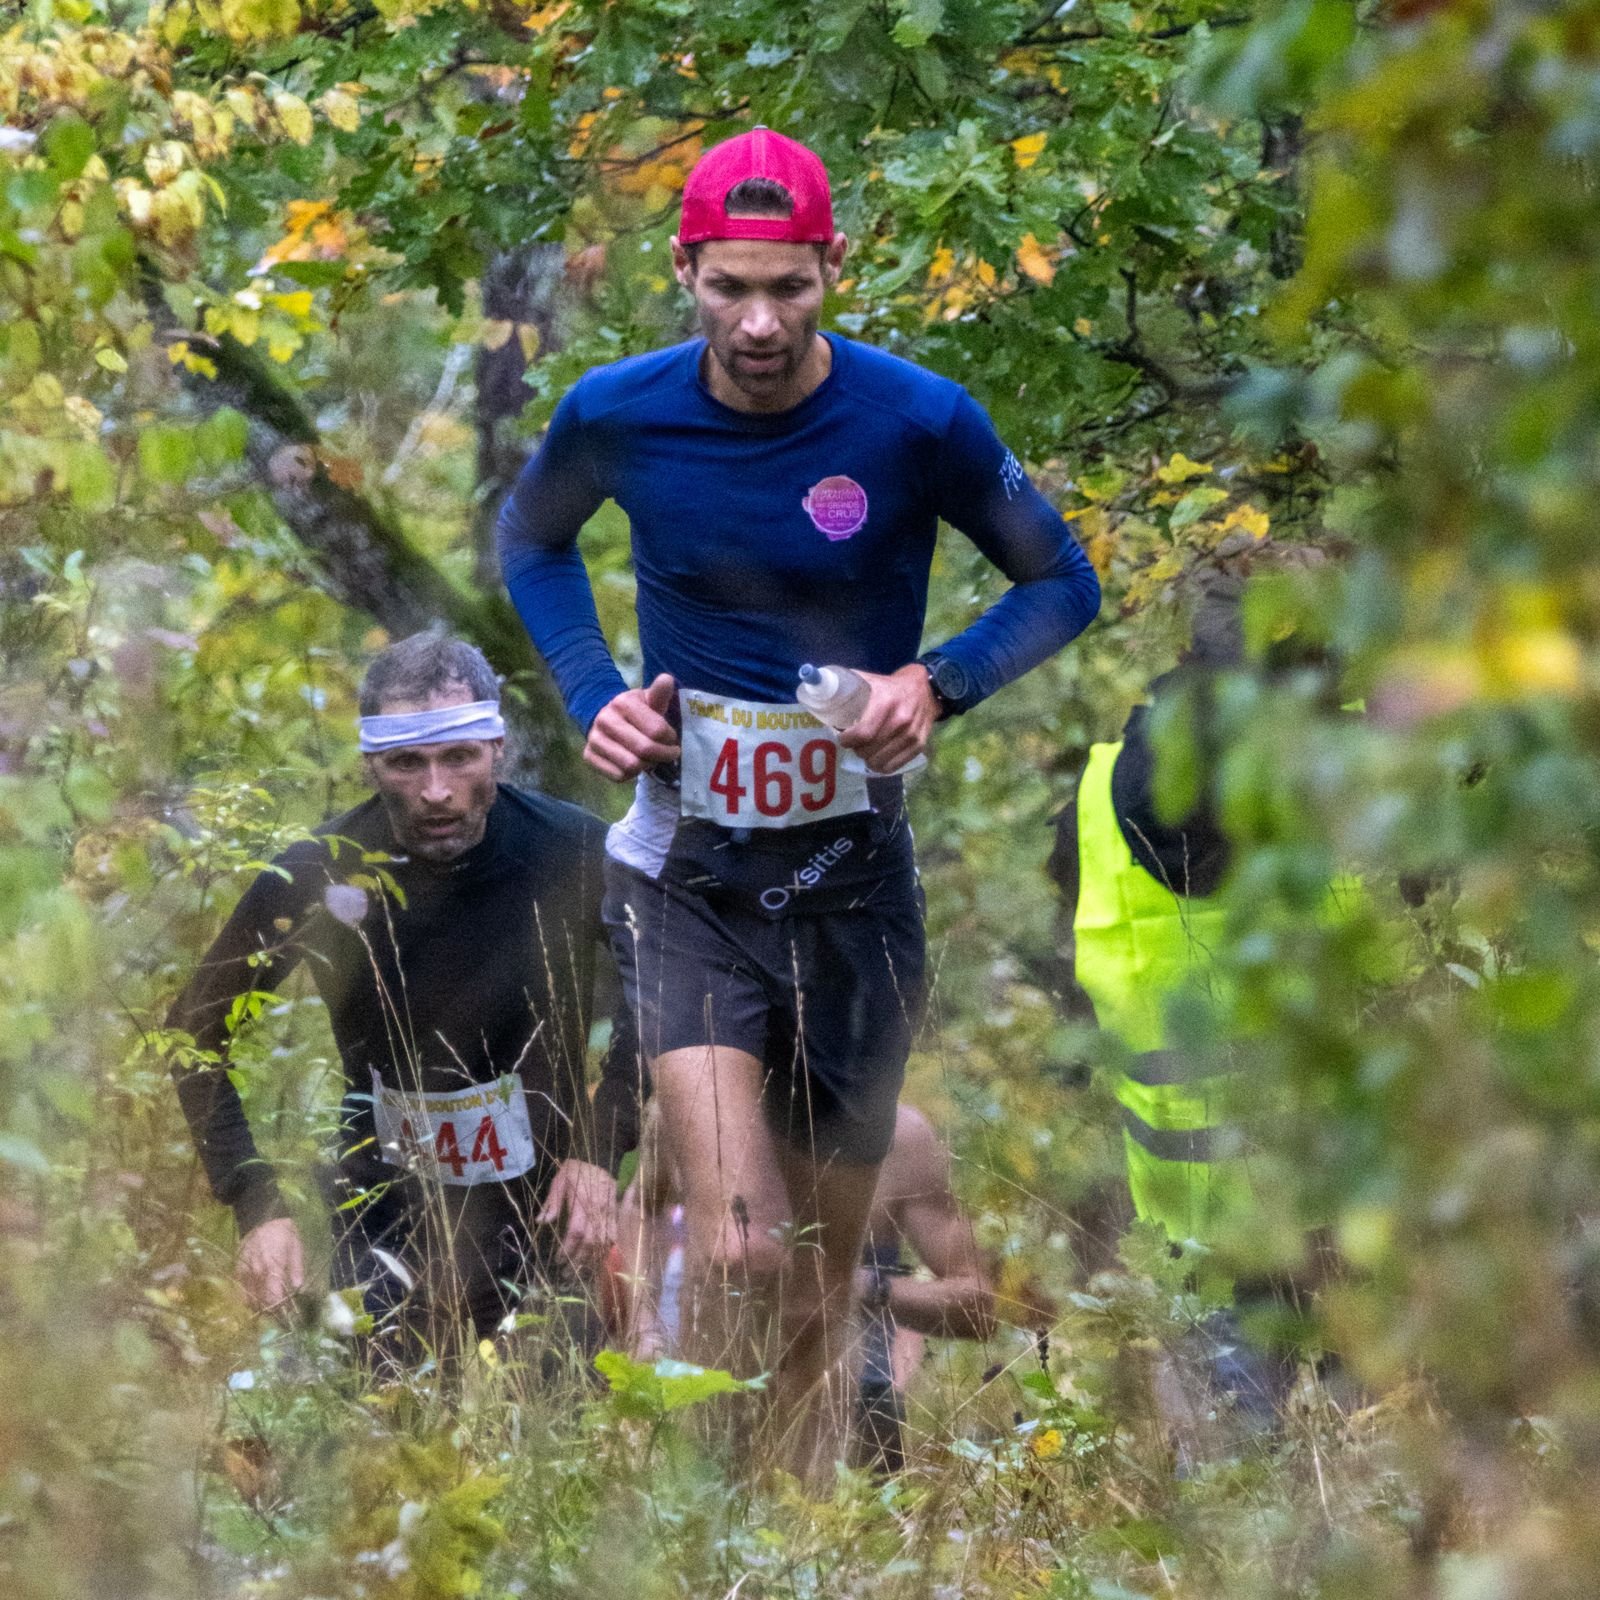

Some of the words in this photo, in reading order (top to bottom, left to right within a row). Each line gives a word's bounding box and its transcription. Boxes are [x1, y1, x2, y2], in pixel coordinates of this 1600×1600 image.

[828, 509, 860, 519] CRUS
[731, 708, 752, 728] DU
[709, 738, 836, 817] 469
